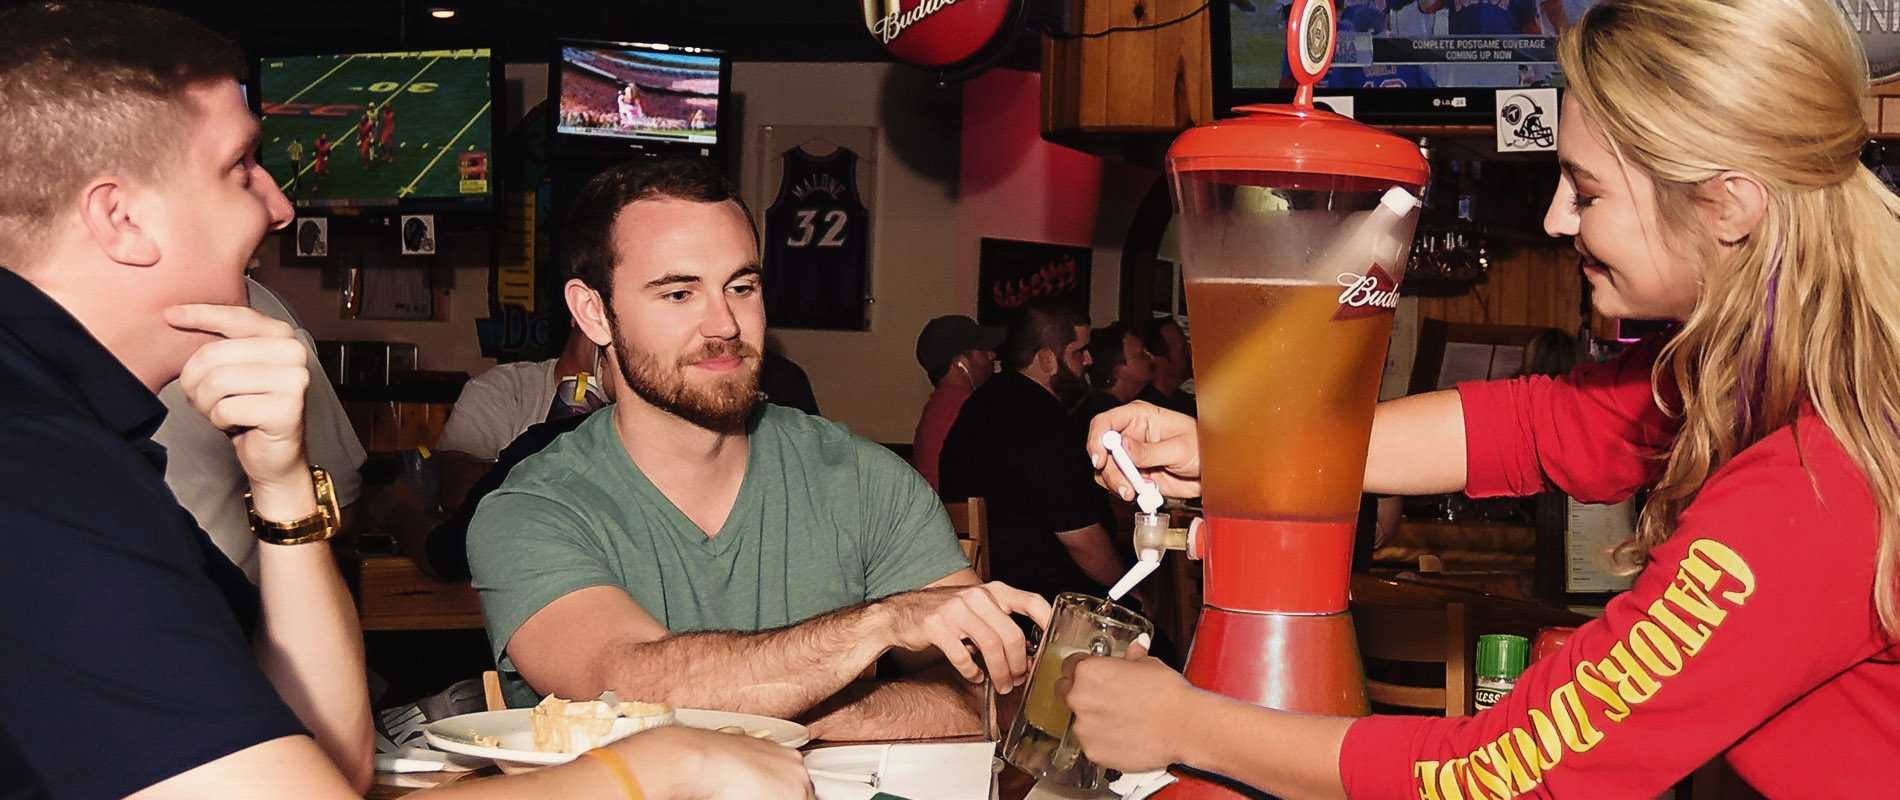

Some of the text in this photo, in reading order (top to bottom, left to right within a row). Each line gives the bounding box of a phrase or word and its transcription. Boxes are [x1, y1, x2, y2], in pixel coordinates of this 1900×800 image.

[1412, 39, 1546, 49] COMPLETE POSTGAME COVERAGE
[1446, 50, 1512, 60] COMING UP NOW
[787, 209, 848, 247] 32
[1575, 538, 1756, 723] GATORS
